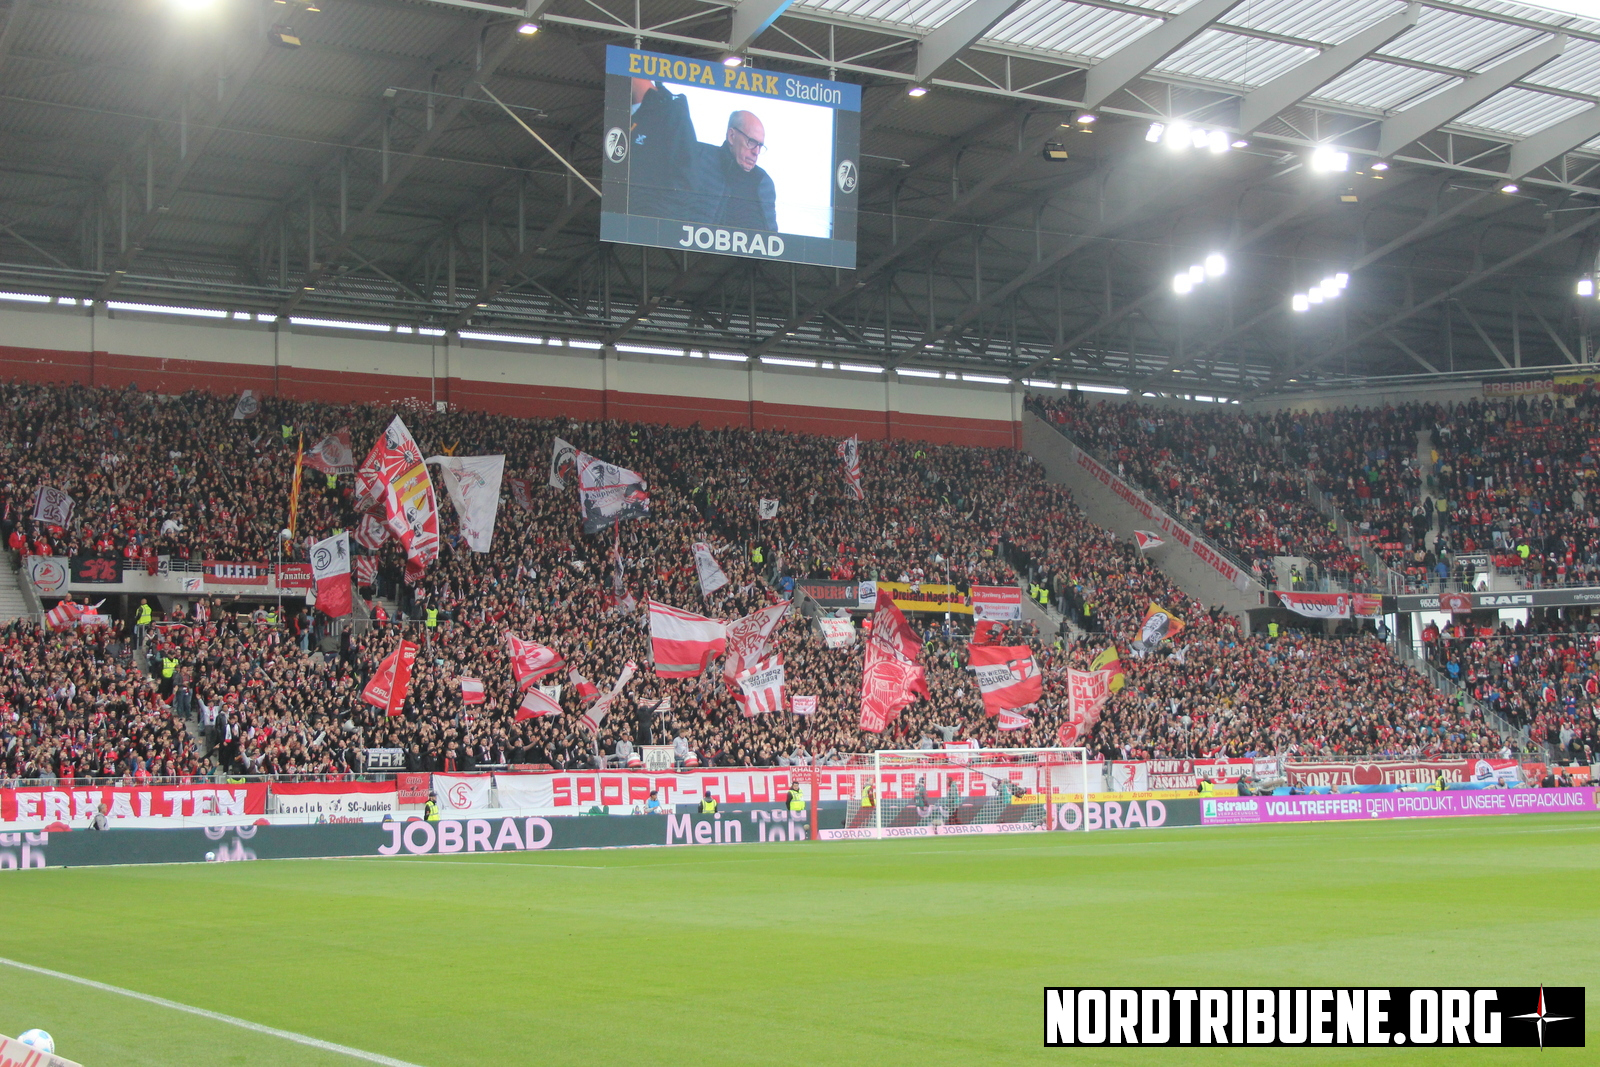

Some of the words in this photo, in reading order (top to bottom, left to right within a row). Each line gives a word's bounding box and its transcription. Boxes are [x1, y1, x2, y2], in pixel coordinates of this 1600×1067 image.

[628, 53, 716, 86] EUROPA
[723, 68, 779, 95] PARK
[785, 78, 841, 105] Stadion
[679, 225, 785, 257] JOBRAD
[1483, 379, 1554, 394] FREIBURG
[1076, 452, 1111, 486] LETZTES
[1110, 481, 1154, 520] HEIMSPIEL
[1172, 525, 1191, 547] UHR
[1192, 541, 1239, 583] SEEPARK!
[278, 571, 311, 581] Fanatics
[926, 591, 948, 605] Magic
[1480, 595, 1533, 605] RAFI
[1298, 599, 1334, 613] 100%
[1072, 680, 1105, 699] CLUB
[1146, 760, 1180, 773] FIGHT
[1196, 766, 1214, 777] Red
[1296, 770, 1351, 787] FORZA
[552, 774, 791, 808] SPORT-CLUB
[818, 771, 987, 801] FRIBURG
[15, 789, 248, 822] ERHALTEN
[347, 801, 392, 812] SC-Junkies
[1217, 799, 1258, 811] straub
[1266, 799, 1362, 816] VOLLTREFFER!
[1366, 798, 1395, 813] DEIN
[1397, 796, 1457, 811] PRODUKT,
[1460, 794, 1505, 809] UNSERE
[1508, 792, 1586, 808] VERPACKUNG.
[1043, 800, 1167, 831] JOBRAD
[377, 817, 553, 855] JOBRAD
[666, 812, 742, 845] Mein
[828, 829, 872, 839] JOBRAD
[886, 827, 928, 837] JOBRAD
[942, 824, 983, 835] JOBRAD
